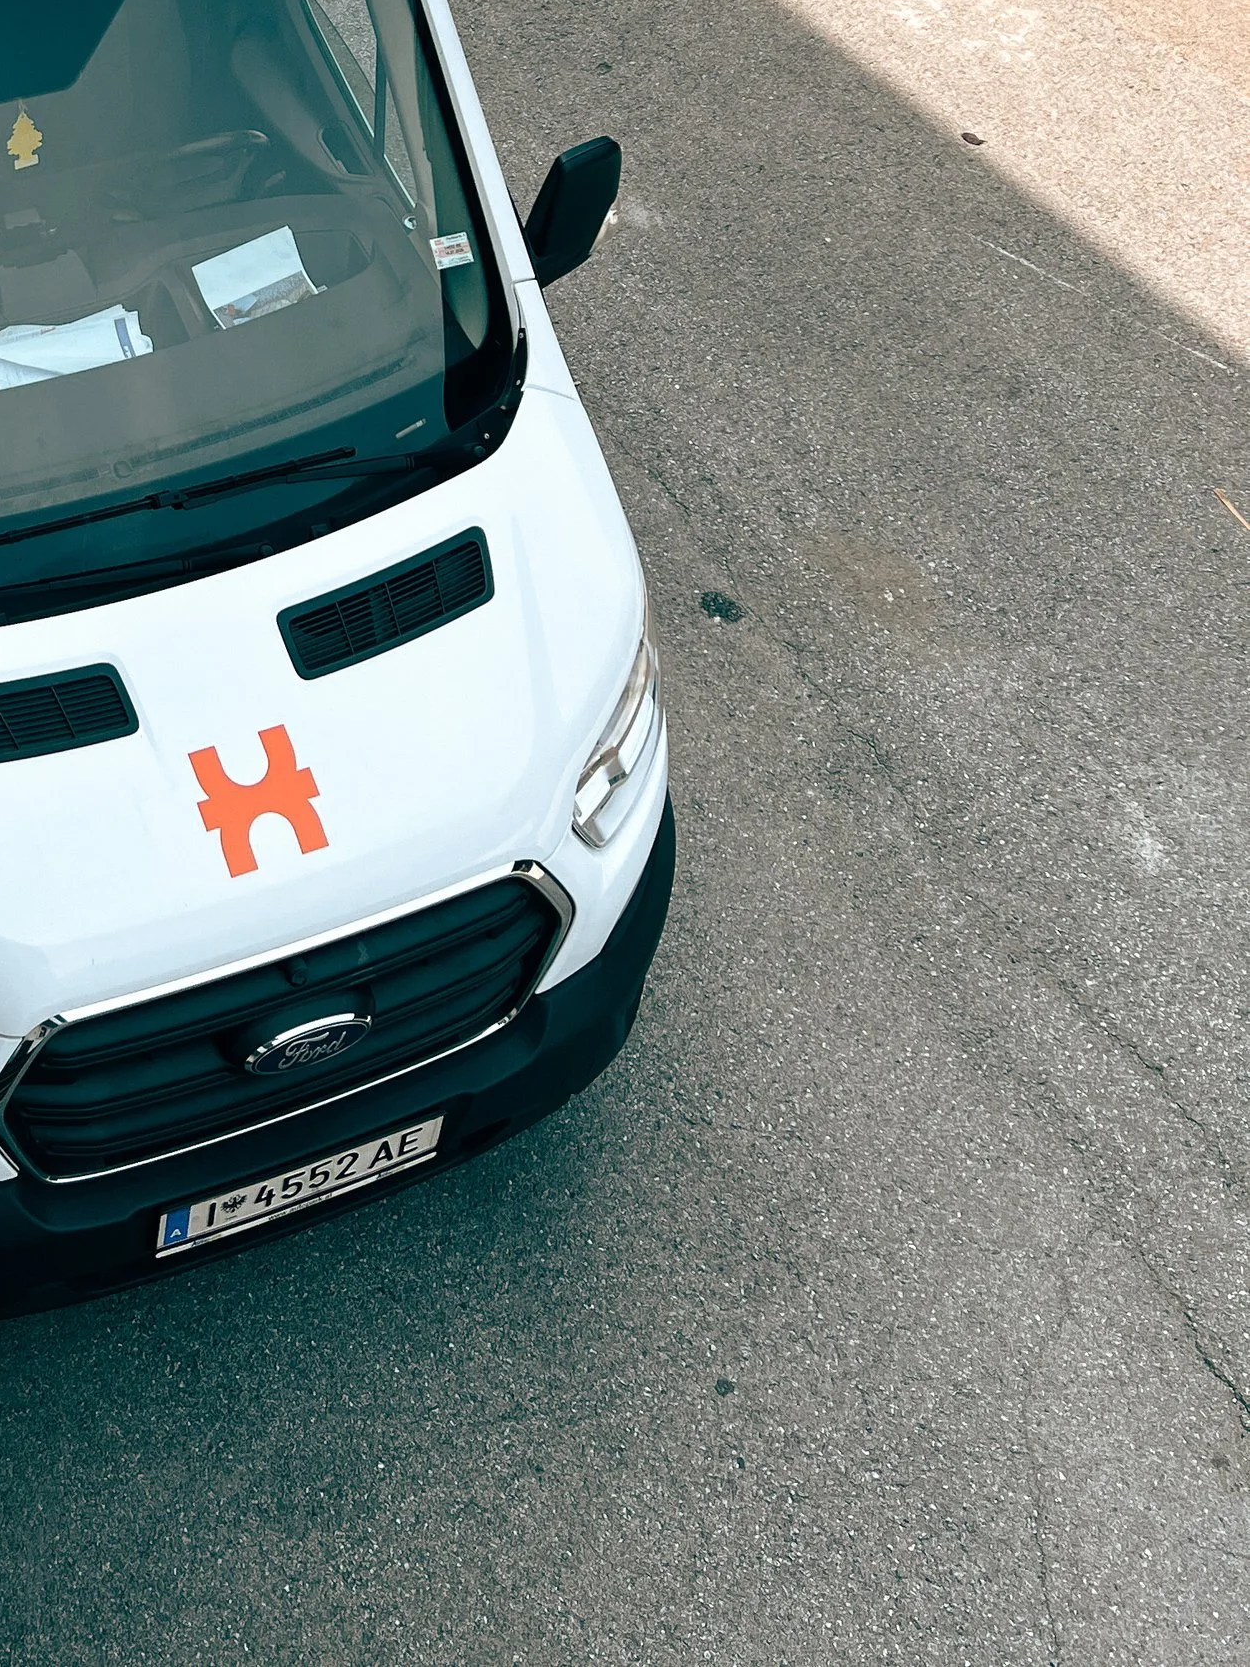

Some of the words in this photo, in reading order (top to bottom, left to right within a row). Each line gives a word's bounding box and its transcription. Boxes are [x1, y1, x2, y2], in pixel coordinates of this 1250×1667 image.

[278, 1031, 347, 1069] Ford
[254, 1151, 359, 1208] 4552
[367, 1127, 424, 1170] AE
